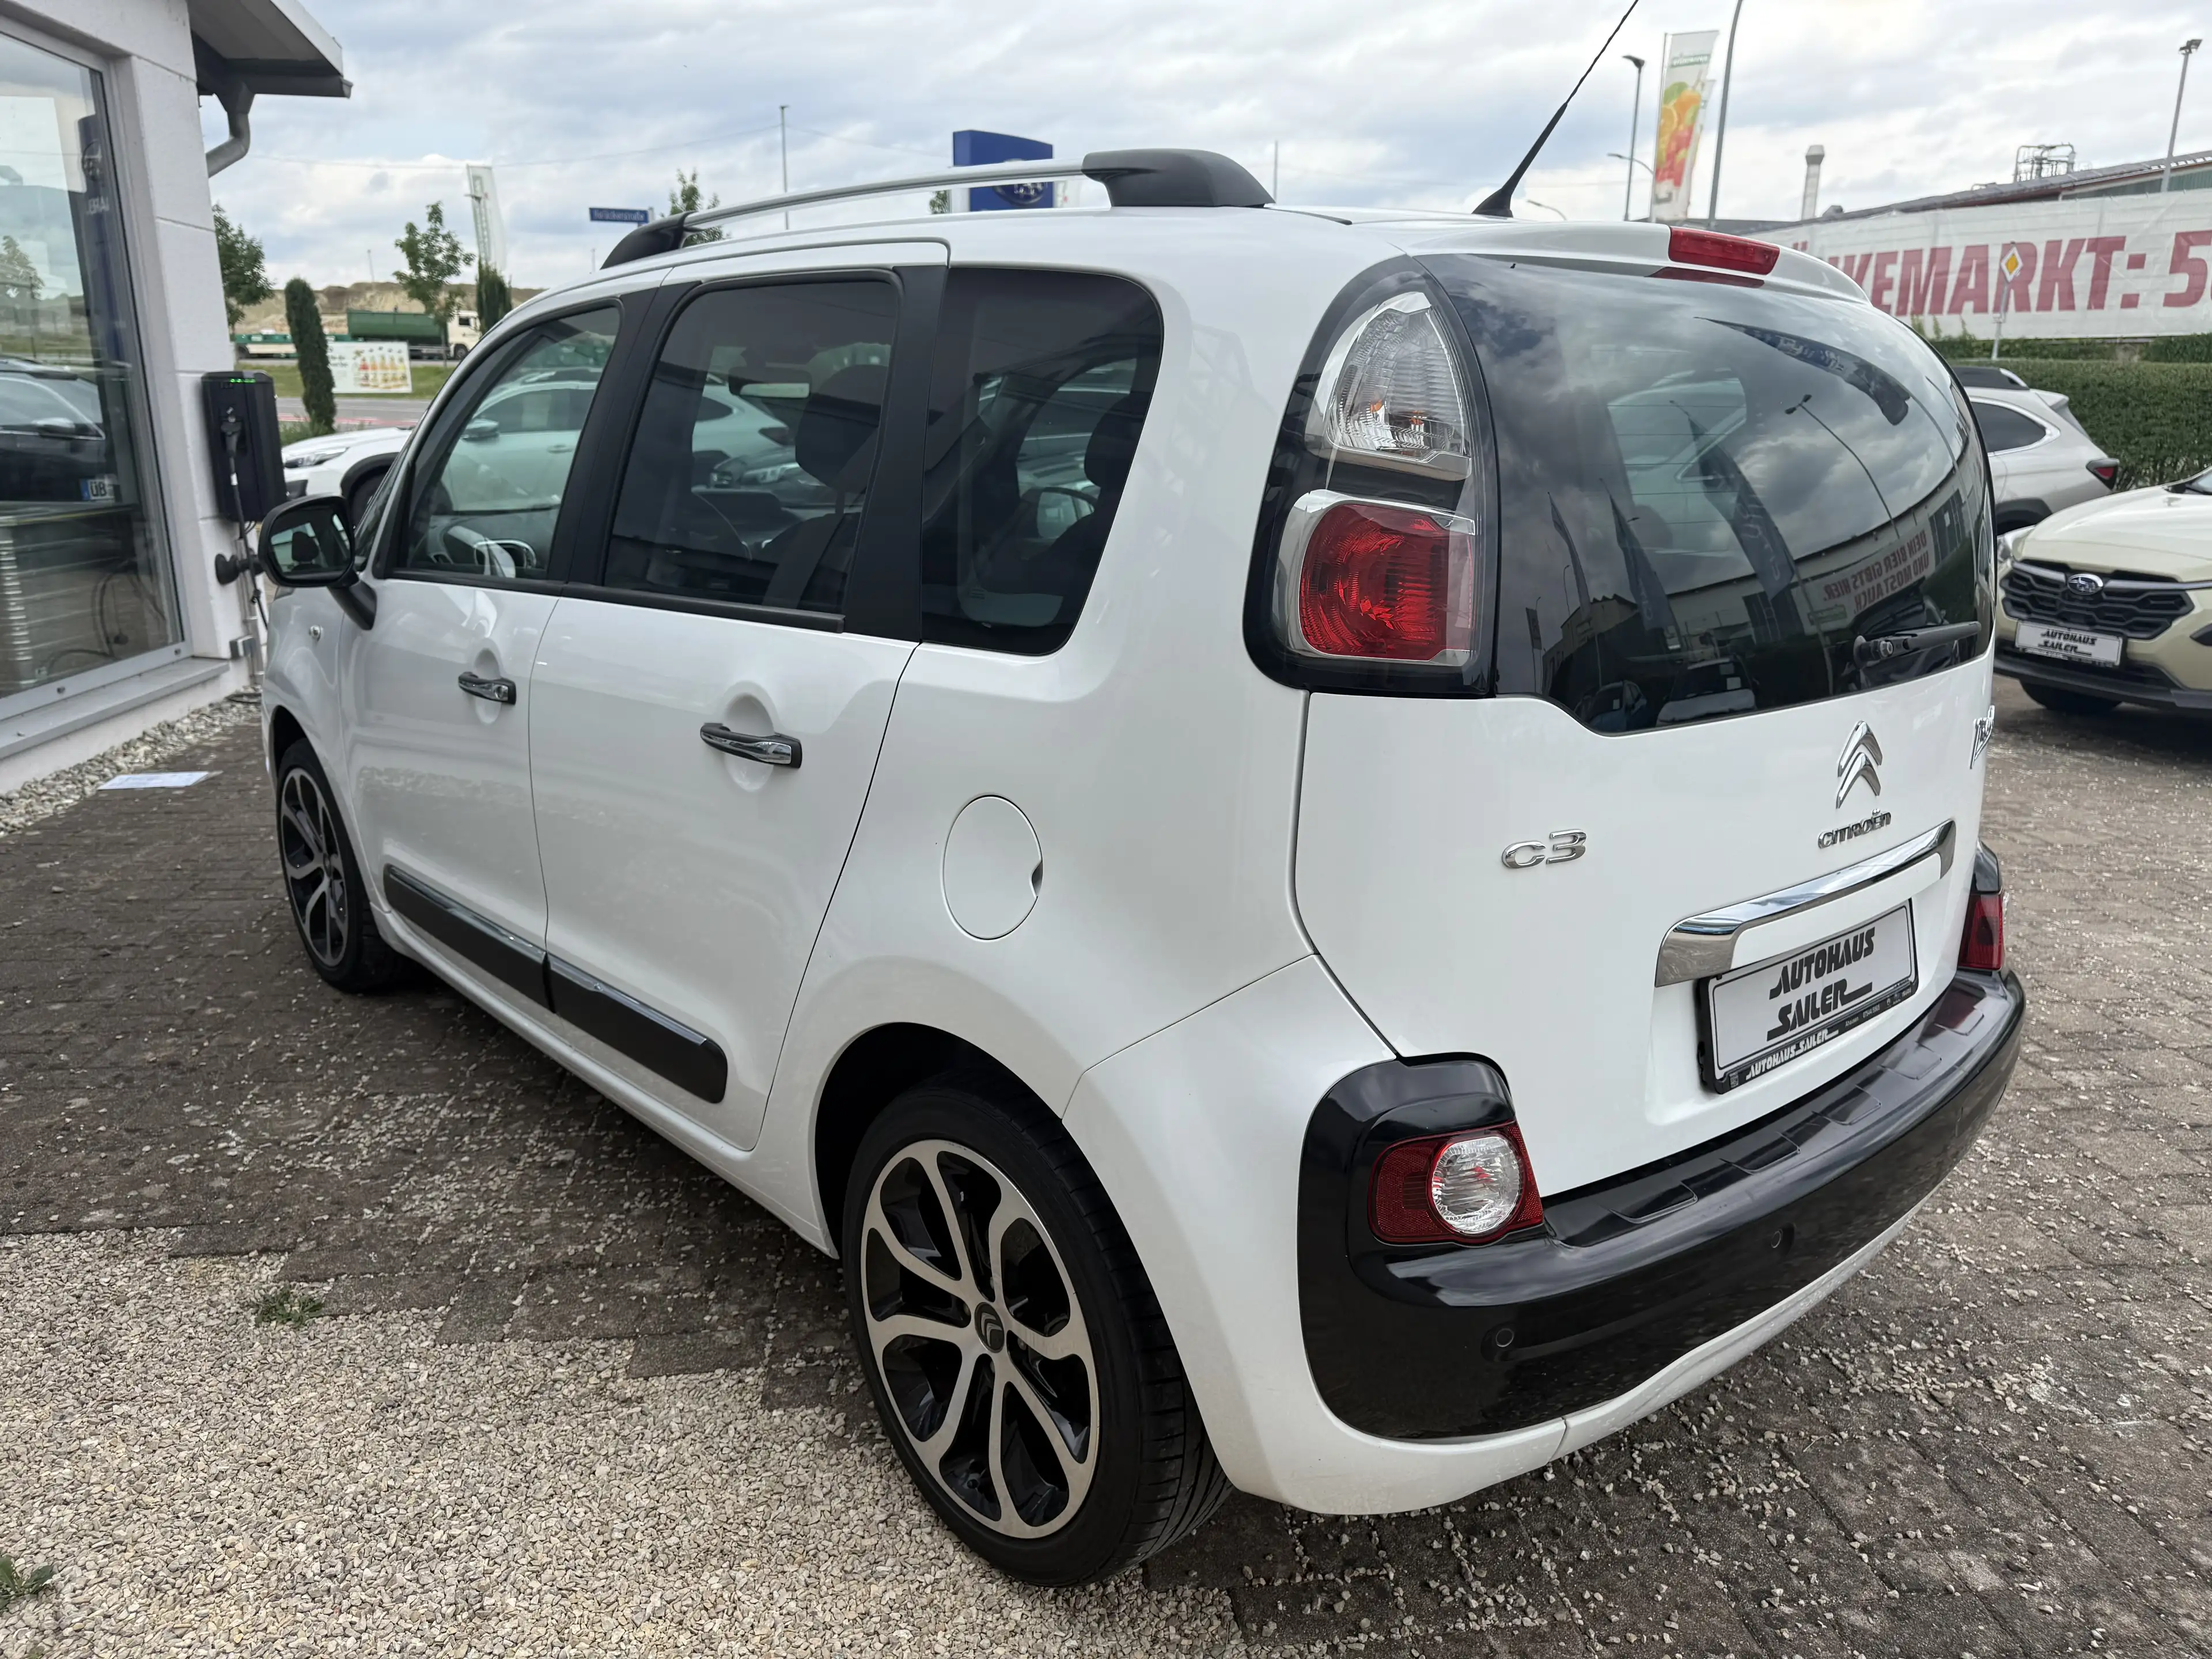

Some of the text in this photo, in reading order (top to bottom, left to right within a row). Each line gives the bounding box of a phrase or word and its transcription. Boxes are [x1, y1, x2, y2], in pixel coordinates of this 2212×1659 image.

[2037, 640, 2092, 656] SAILER
[2041, 628, 2097, 645] AUTOHAUS
[1501, 828, 1587, 869] C3
[1817, 808, 1891, 849] CITROËN
[1769, 926, 1876, 1000] AUTOHAUS
[1766, 978, 1873, 1041] SAILER
[1745, 1046, 1796, 1080] AUTOHAUS
[1795, 1028, 1839, 1056] SAILER
